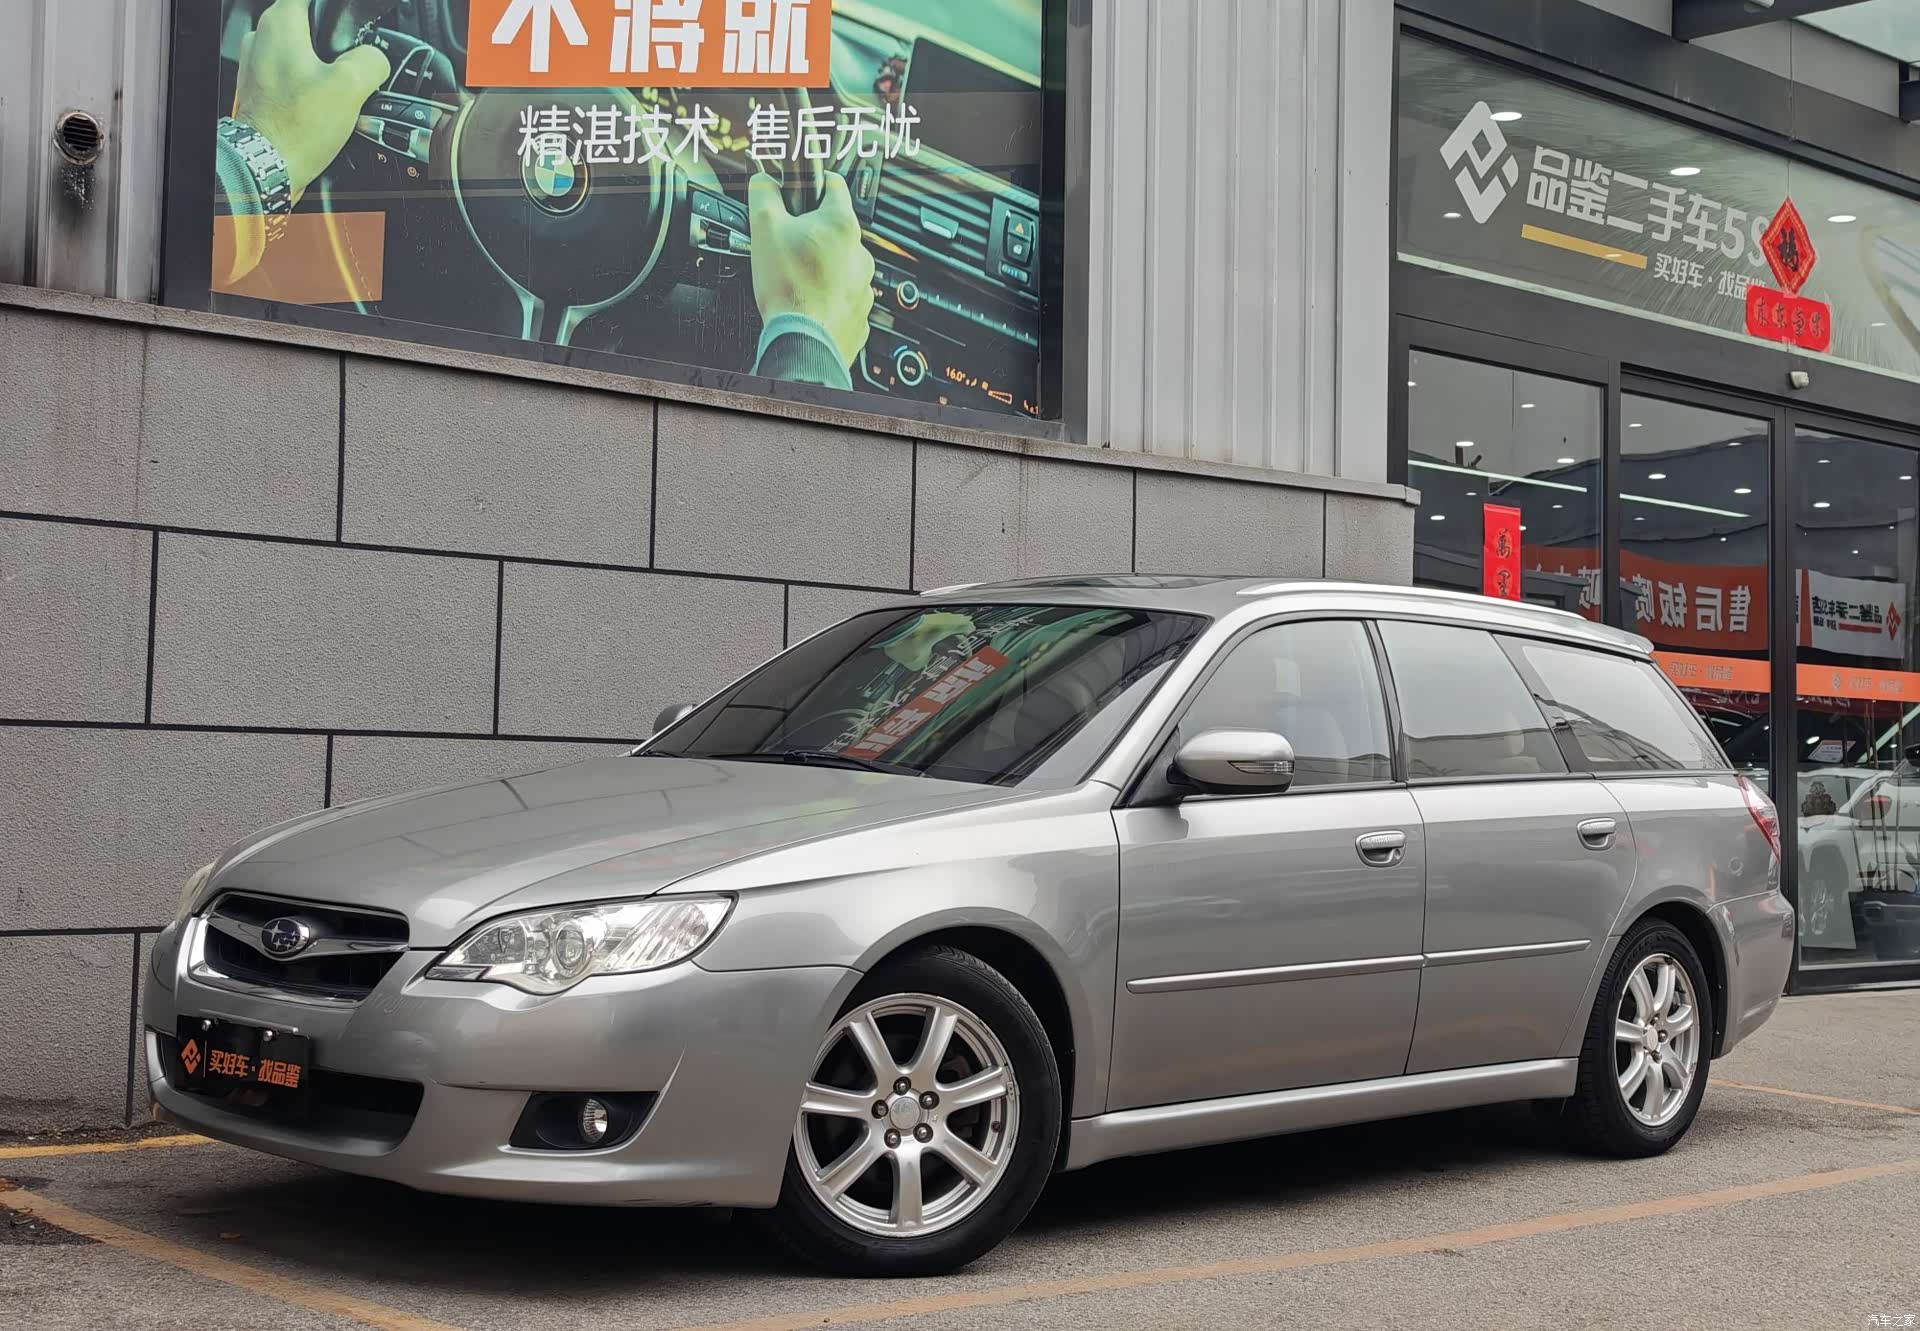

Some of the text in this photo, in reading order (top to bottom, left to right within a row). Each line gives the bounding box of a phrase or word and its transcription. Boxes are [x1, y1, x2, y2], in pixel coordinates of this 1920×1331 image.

[517, 103, 719, 166] 精湛技术
[746, 101, 921, 162] 售后无忧
[209, 1050, 302, 1088] 买好车·找品鉴
